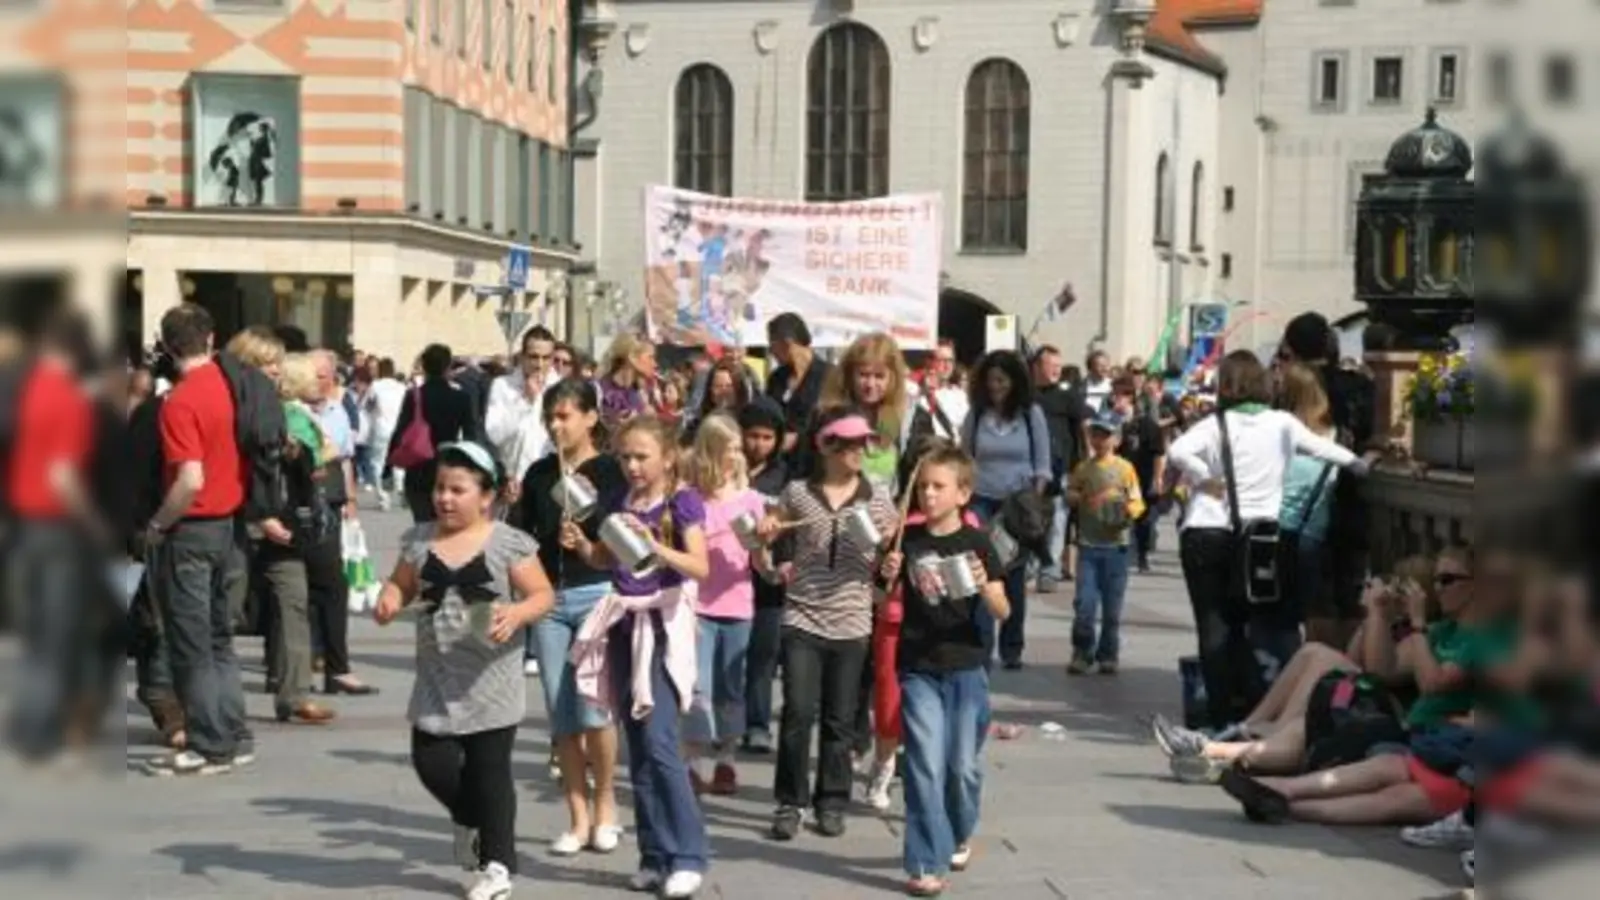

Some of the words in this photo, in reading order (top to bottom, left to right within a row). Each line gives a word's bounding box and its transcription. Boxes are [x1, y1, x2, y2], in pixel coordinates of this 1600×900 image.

[805, 225, 843, 246] IST
[858, 226, 908, 247] EINE
[804, 250, 909, 272] SICHERE
[825, 276, 892, 296] BANK
